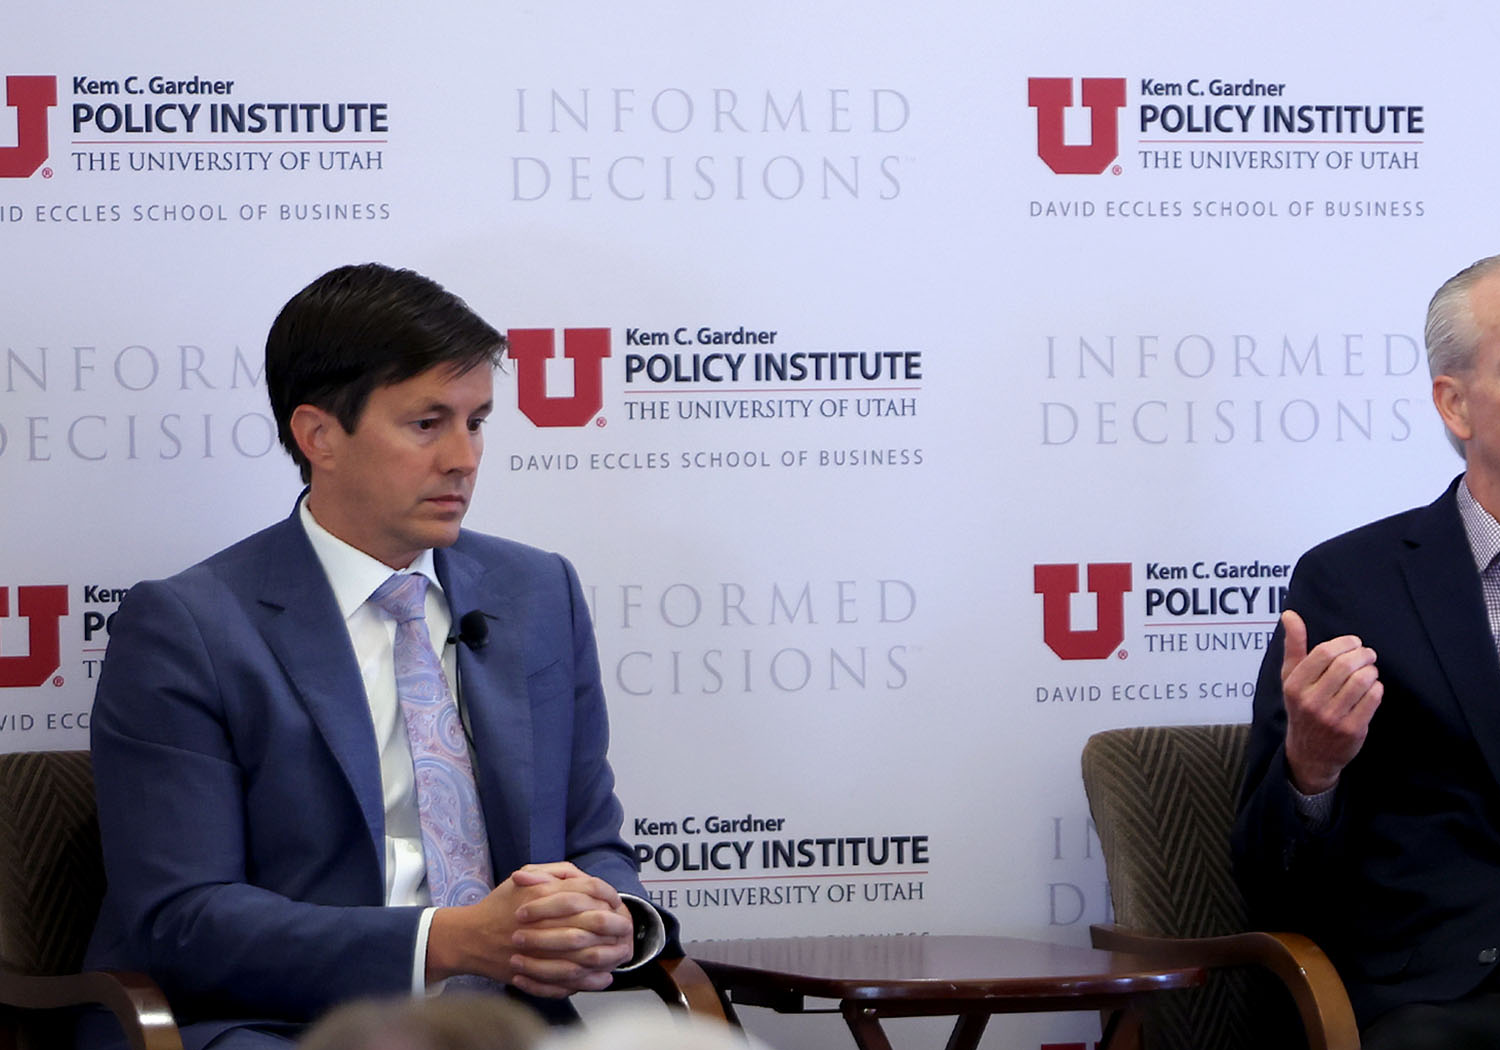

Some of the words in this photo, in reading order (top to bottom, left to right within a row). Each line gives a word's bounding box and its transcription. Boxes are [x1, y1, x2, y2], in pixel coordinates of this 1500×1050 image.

[72, 75, 120, 95] Kem
[123, 74, 145, 95] C.
[148, 74, 235, 96] Gardner
[1140, 78, 1183, 97] Kem
[1186, 78, 1205, 97] C.
[1208, 78, 1286, 97] Gardner
[72, 101, 201, 134] POLICY
[210, 102, 389, 134] INSTITUTE
[515, 87, 911, 134] INFORMED
[1140, 104, 1256, 134] POLICY
[1263, 104, 1425, 134] INSTITUTE
[1028, 77, 1127, 175] U
[70, 150, 121, 172] THE
[128, 151, 273, 172] UNIVERSITY
[279, 150, 311, 172] OF
[318, 150, 383, 172] UTAH
[1138, 150, 1183, 170] THE
[1190, 150, 1320, 170] UNIVERSITY
[1325, 150, 1354, 170] OF
[1360, 150, 1419, 170] UTAH
[510, 154, 901, 202] DECISIONS
[35, 203, 121, 223] ECCLES
[132, 203, 228, 223] SCHOOL
[238, 203, 268, 222] OF
[279, 202, 390, 222] BUSINESS
[1029, 200, 1096, 218] DAVID
[1105, 200, 1183, 218] ECCLES
[1192, 200, 1279, 218] SCHOOL
[1287, 200, 1315, 218] OF
[1324, 200, 1425, 218] BUSINESS
[625, 327, 670, 347] Kem
[673, 326, 693, 347] C.
[696, 325, 778, 346] Gardner
[5, 344, 268, 393] NFORM
[625, 352, 746, 384] POLICY
[754, 350, 922, 383] INSTITUTE
[1046, 333, 1421, 380] INFORMED
[507, 327, 612, 428] U
[623, 400, 670, 421] THE
[677, 398, 813, 421] UNIVERSITY
[818, 398, 849, 419] OF
[856, 397, 916, 418] UTAH
[1039, 397, 1412, 447] DECISIONS
[0, 411, 277, 462] ECISIO
[509, 453, 579, 472] DAVID
[589, 451, 671, 471] ECCLES
[680, 450, 771, 470] SCHOOL
[780, 449, 808, 468] OF
[818, 447, 924, 467] BUSINESS
[1146, 562, 1188, 581] Kem
[1191, 561, 1210, 581] C.
[1213, 560, 1291, 580] Gardner
[592, 579, 917, 630] FORMED
[1034, 562, 1133, 661] U
[1145, 585, 1261, 617] POLICY
[1143, 633, 1188, 653] THE
[616, 645, 910, 697] CISIONS
[1035, 684, 1102, 704] DAVID
[1111, 683, 1189, 702] ECCLES
[1199, 682, 1255, 699] SCHO
[0, 714, 34, 731] VID
[47, 713, 89, 730] ECC
[634, 817, 678, 837] Kem
[681, 816, 701, 836] C.
[704, 813, 786, 835] Gardner
[635, 840, 753, 873] POLICY
[762, 835, 930, 869] INSTITUTE
[650, 889, 679, 909] HE
[686, 884, 821, 908] UNIVERSITY
[826, 883, 856, 904] OF
[863, 881, 924, 903] UTAH
